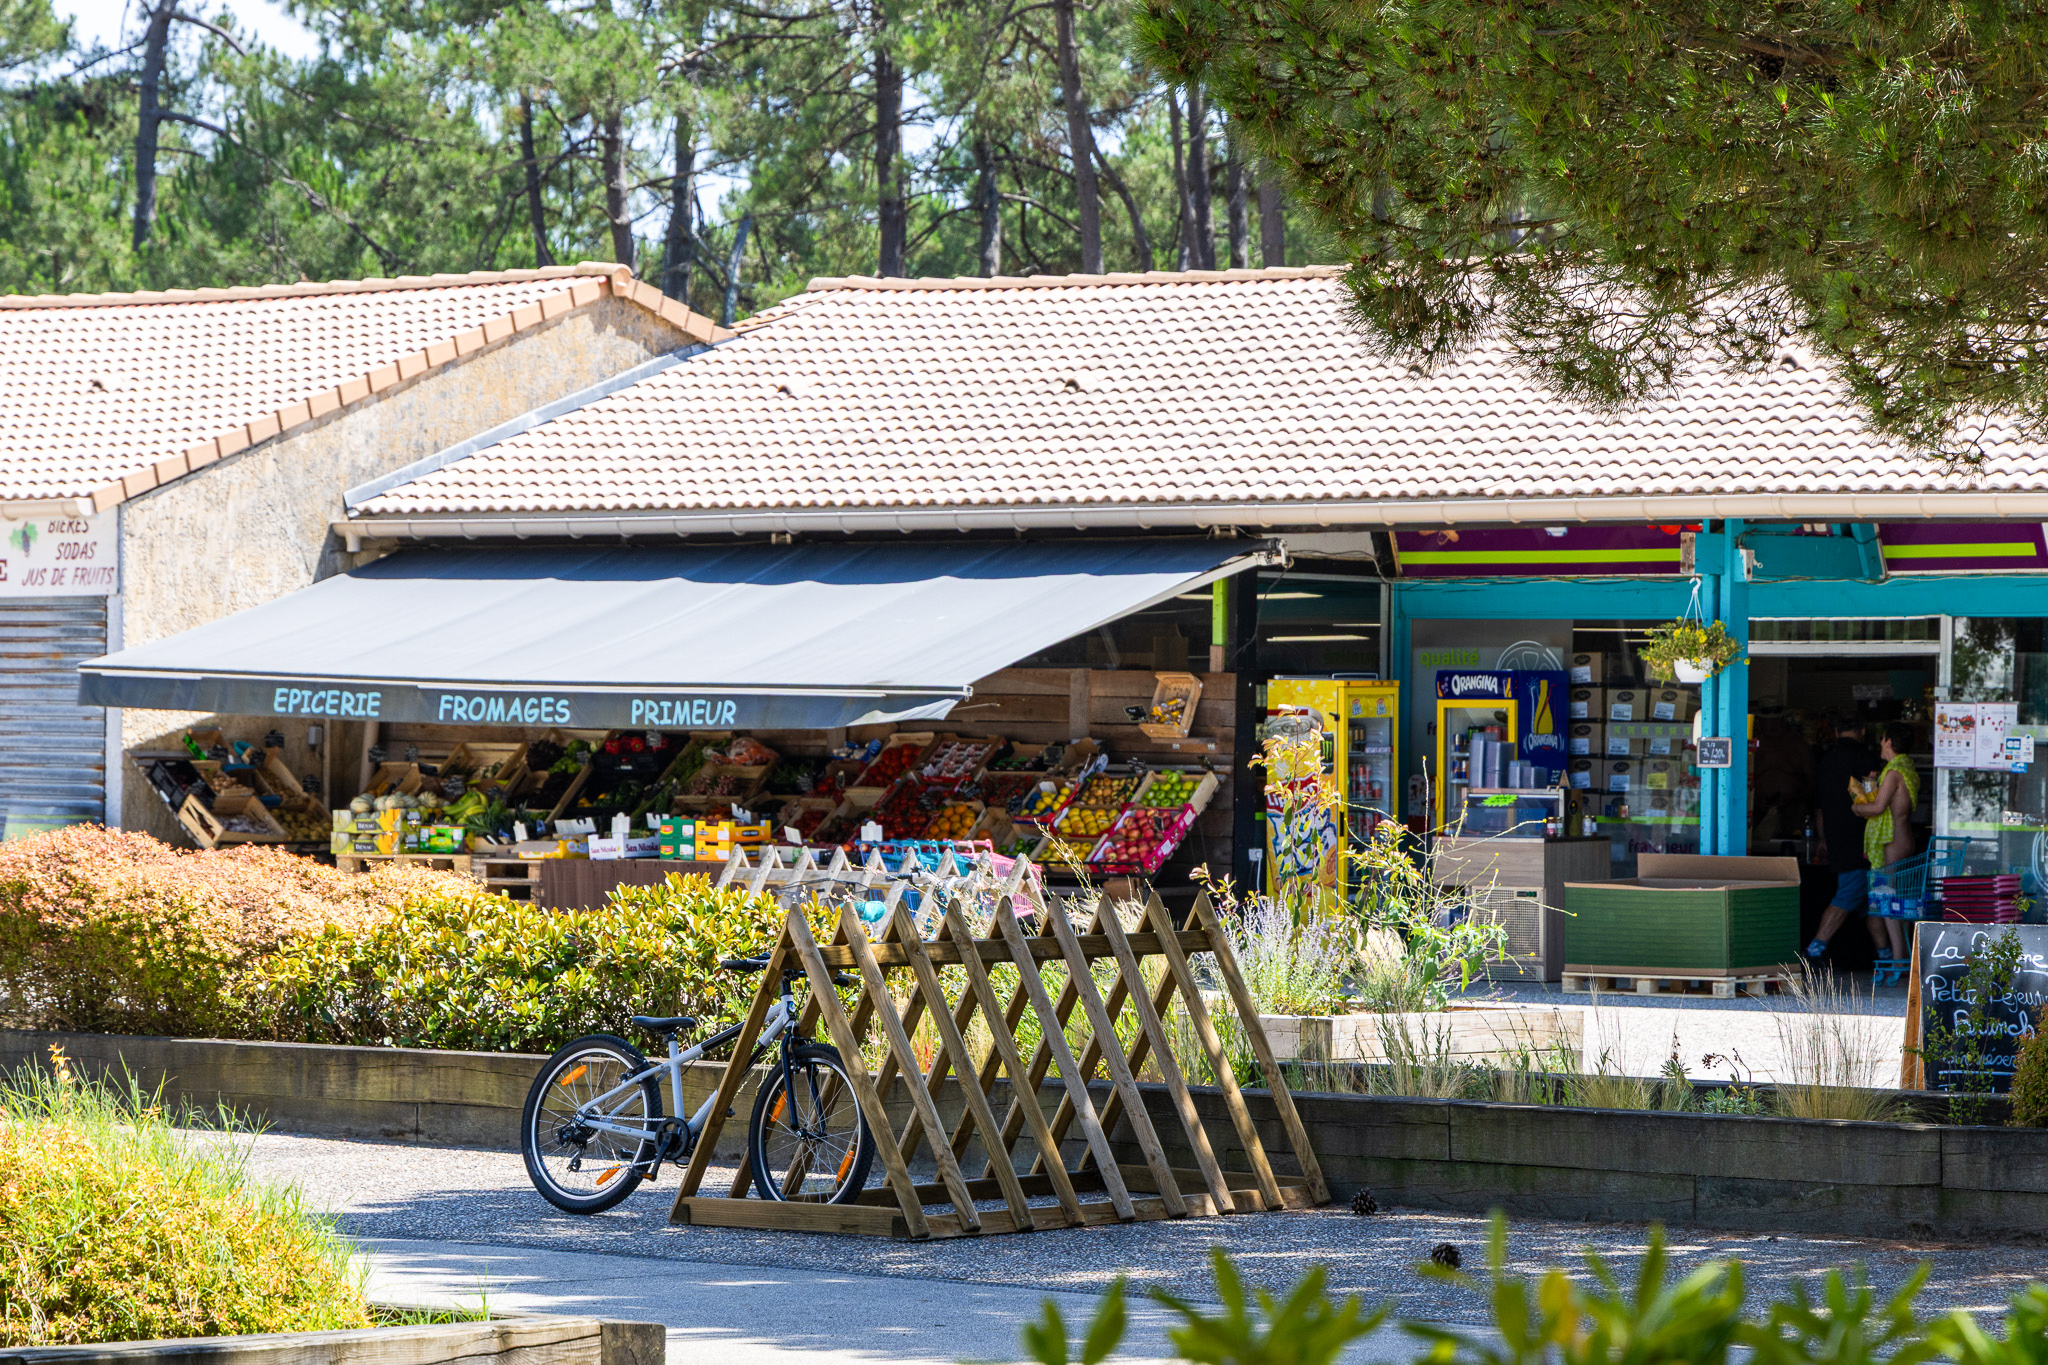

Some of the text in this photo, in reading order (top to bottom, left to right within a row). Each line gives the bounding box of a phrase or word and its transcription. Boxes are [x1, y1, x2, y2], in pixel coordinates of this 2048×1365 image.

[56, 541, 97, 560] SODAS
[22, 566, 114, 586] JUS DE FRUITS
[1420, 648, 1479, 667] qualité
[1452, 674, 1499, 695] ORANGINA
[273, 688, 737, 726] EPICERIE FROMAGES PRIMEUR
[1528, 733, 1558, 750] ORANGINA
[625, 844, 637, 852] San
[638, 842, 658, 852] Nicola
[1931, 931, 1966, 959] La
